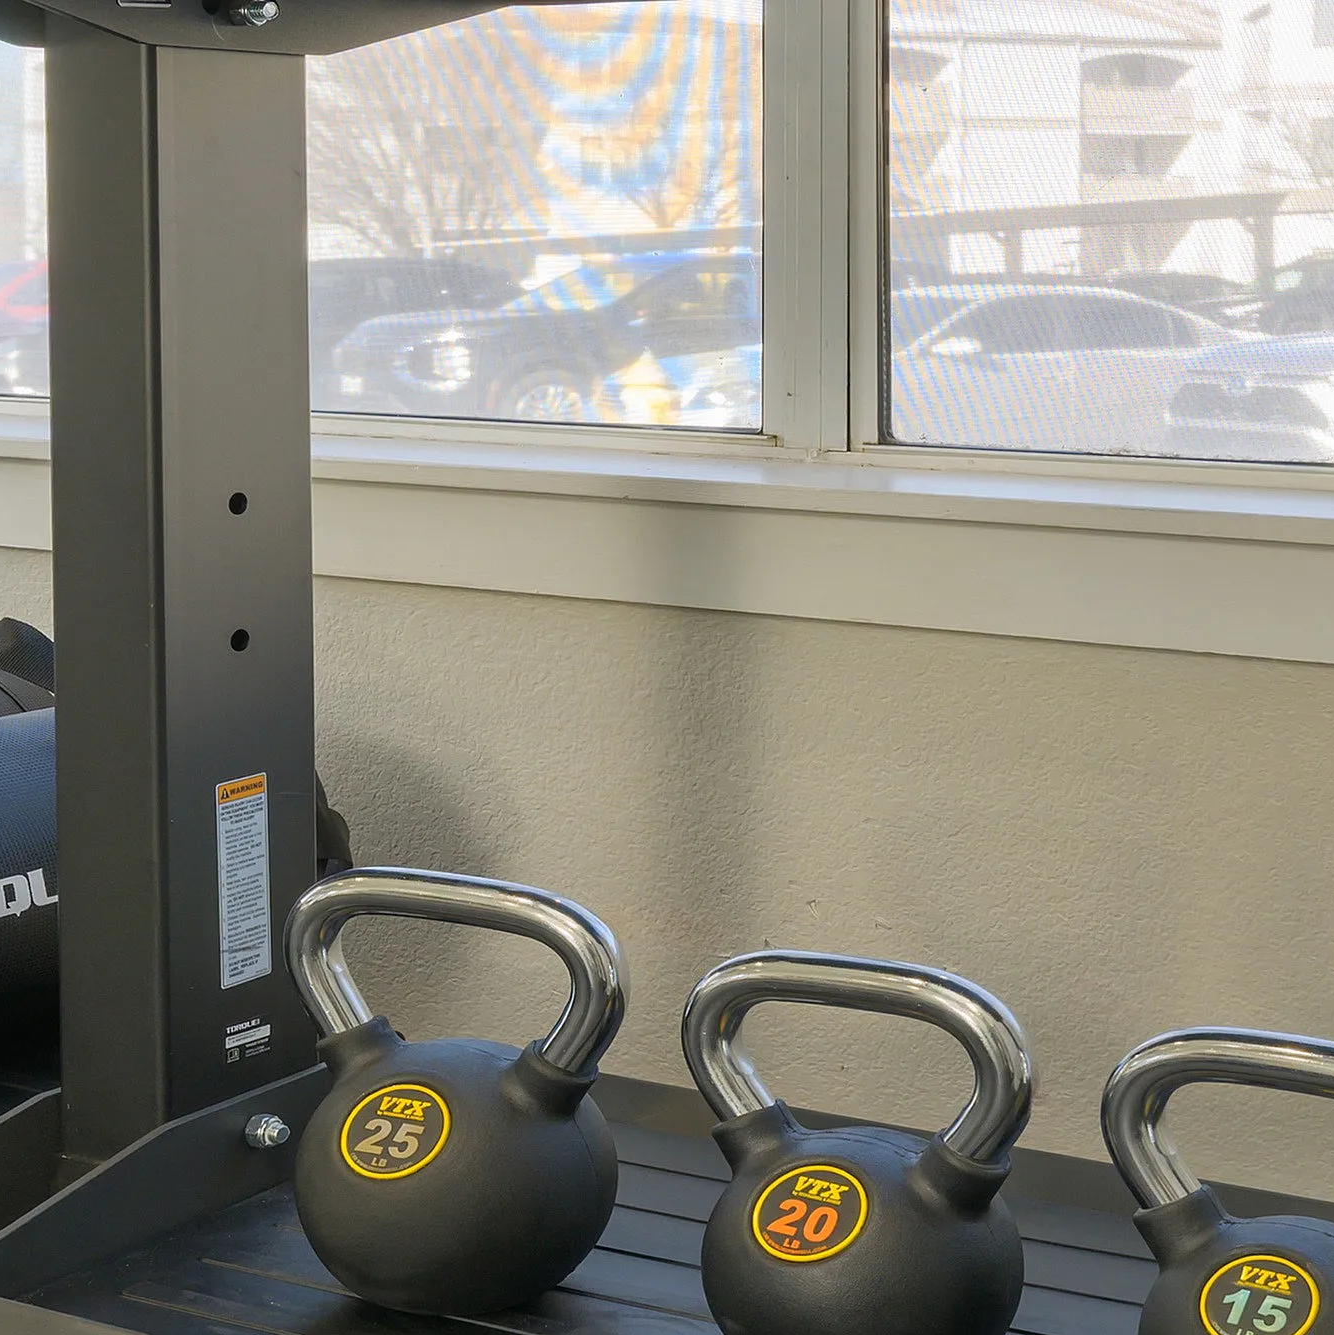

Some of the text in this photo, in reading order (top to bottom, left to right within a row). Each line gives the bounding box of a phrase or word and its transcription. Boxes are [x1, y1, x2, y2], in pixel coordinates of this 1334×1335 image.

[230, 781, 263, 796] WARNING
[379, 1096, 432, 1116] VTX
[353, 1118, 425, 1159] 25
[371, 1157, 387, 1167] LB
[794, 1175, 849, 1200] VTX
[766, 1198, 839, 1243] 20
[783, 1238, 801, 1249] LB
[1240, 1265, 1297, 1290] VTX
[1222, 1288, 1292, 1333] 15
